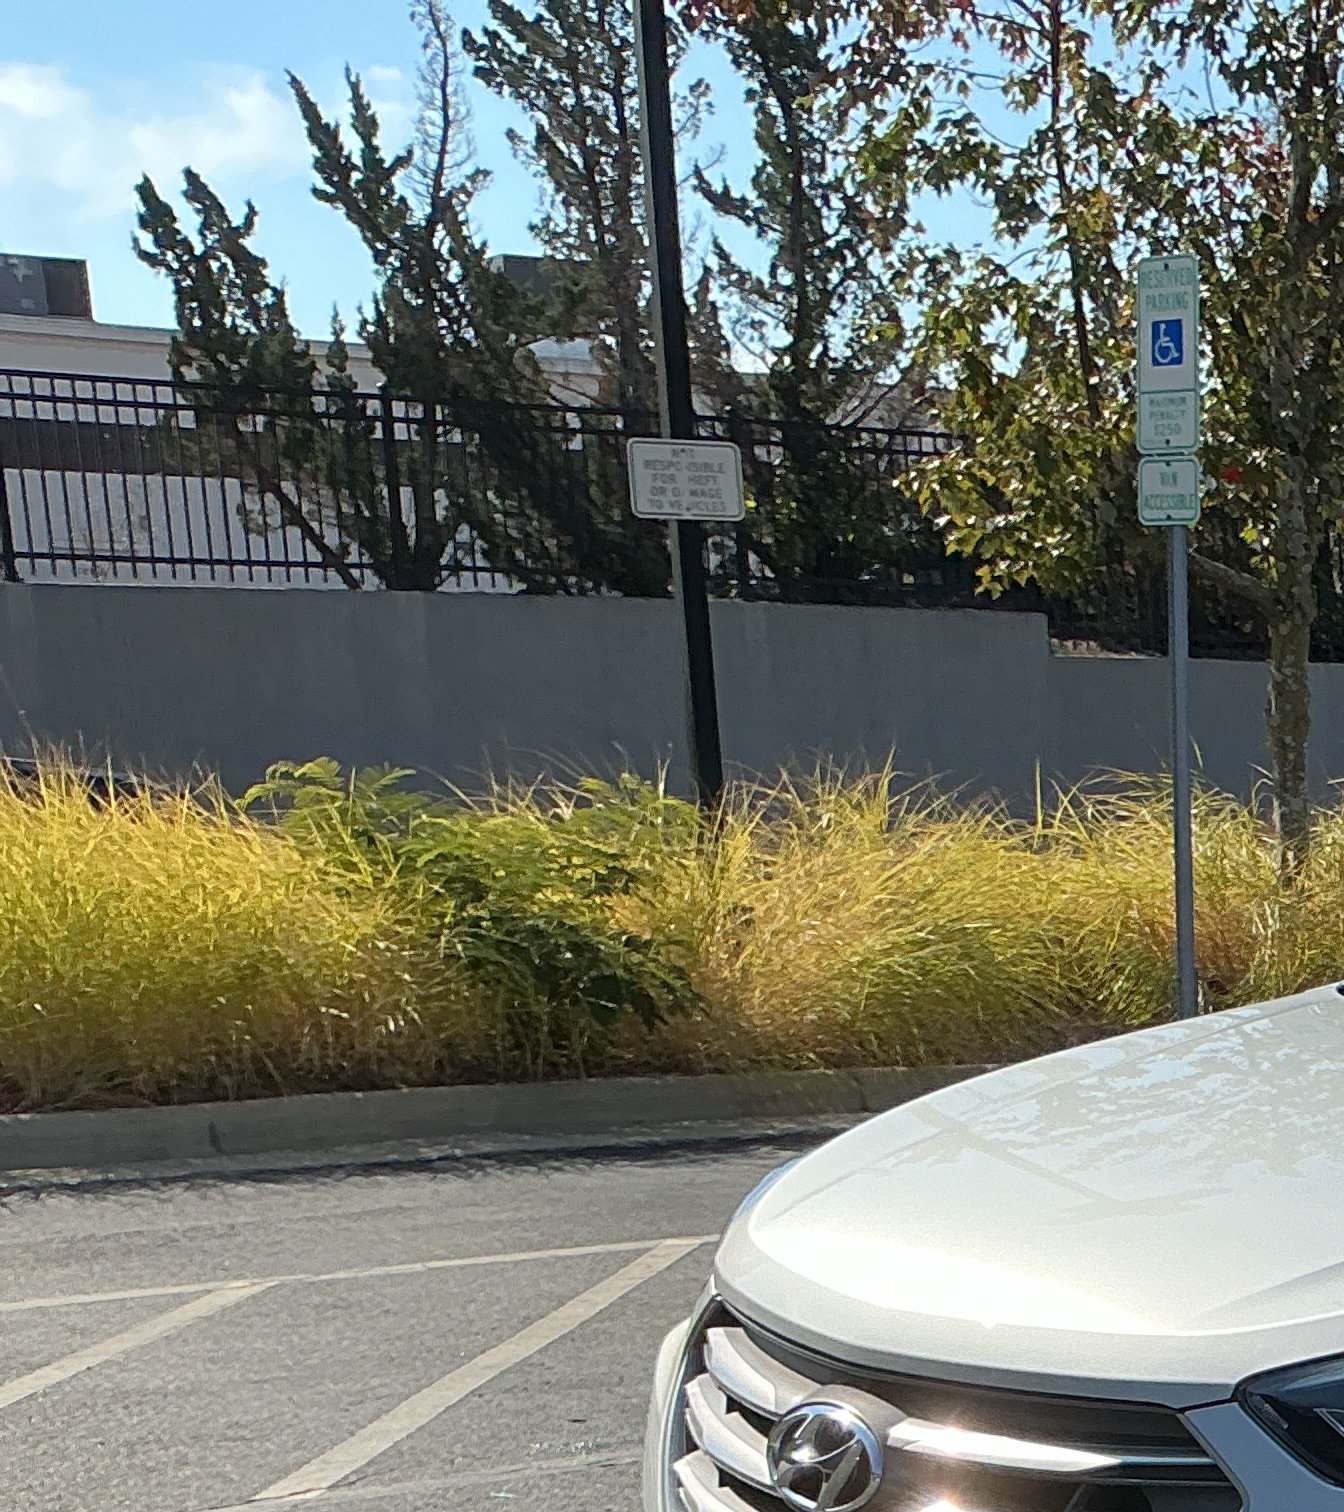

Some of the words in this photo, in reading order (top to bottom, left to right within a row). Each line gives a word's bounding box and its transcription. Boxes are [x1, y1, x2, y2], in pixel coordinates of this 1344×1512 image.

[1146, 291, 1189, 310] PARKING
[1154, 422, 1182, 437] $250
[671, 448, 696, 459] NT
[643, 459, 726, 475] RESPOSIBLE
[671, 487, 723, 500] DMAGE
